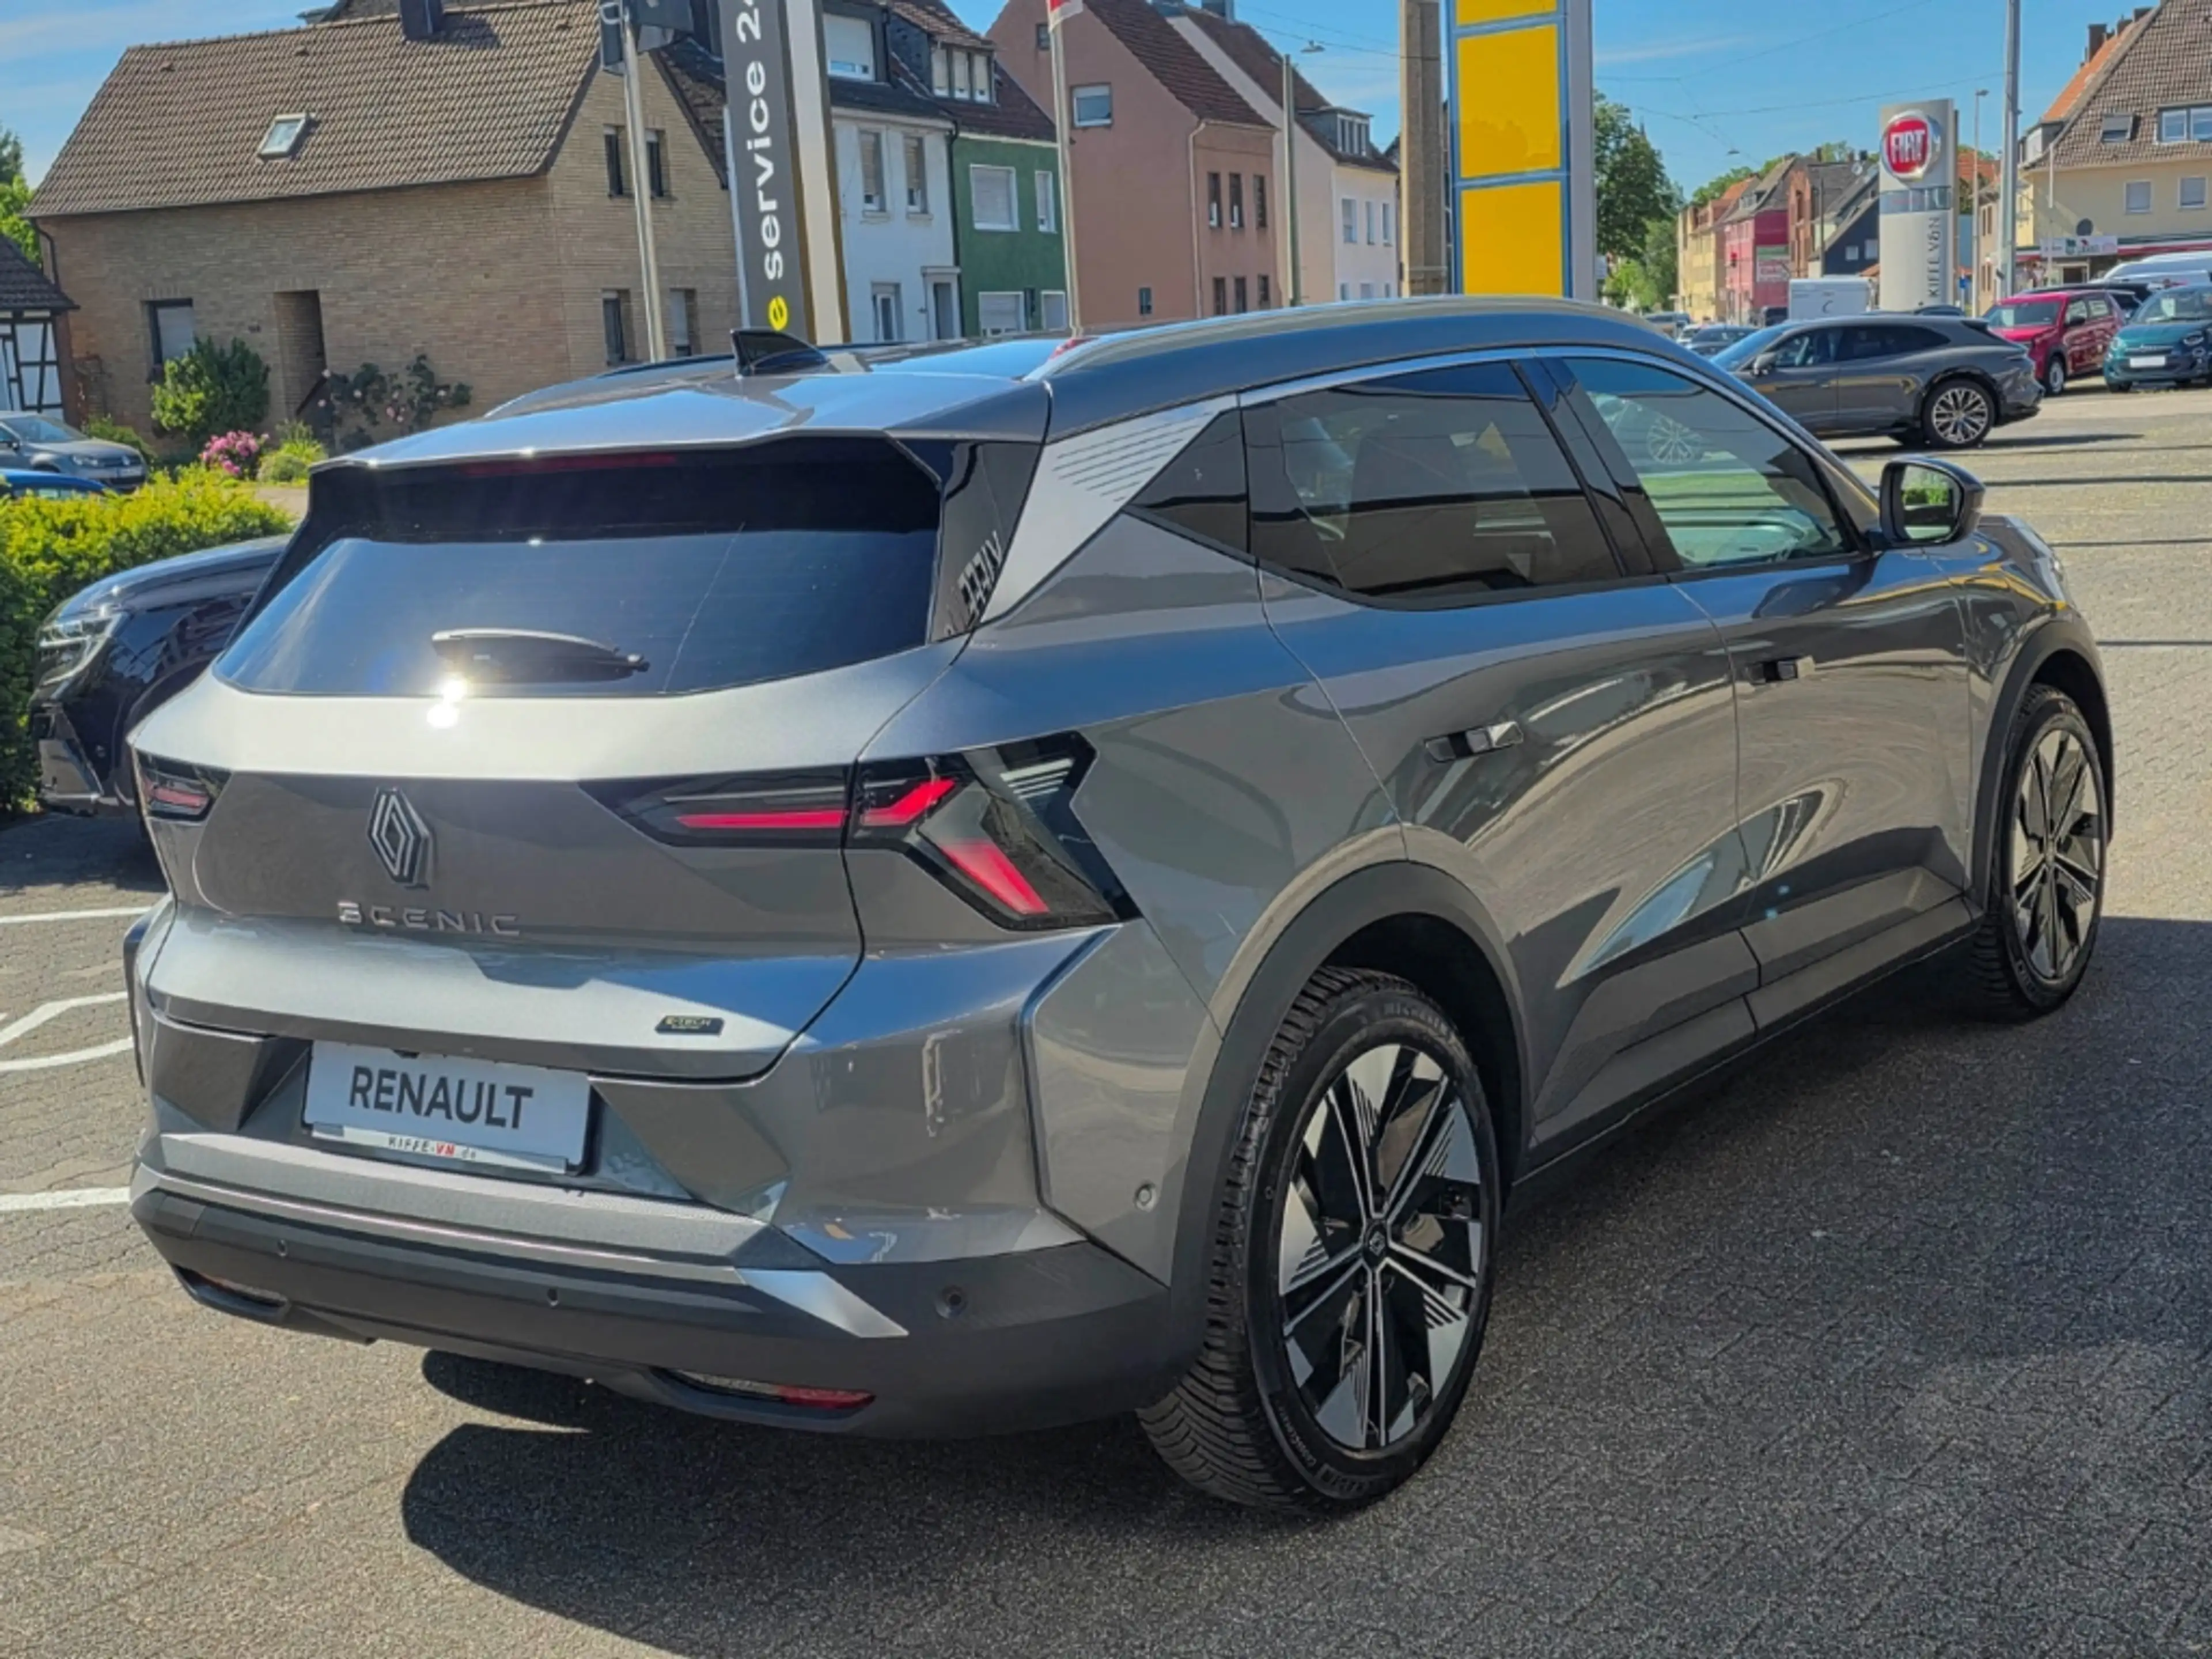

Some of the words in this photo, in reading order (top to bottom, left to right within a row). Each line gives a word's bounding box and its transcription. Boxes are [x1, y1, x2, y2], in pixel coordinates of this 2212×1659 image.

[736, 0, 762, 44] 2
[1890, 129, 1925, 163] FIAT
[746, 60, 784, 281] service
[337, 901, 520, 935] SCENIC
[349, 1066, 533, 1129] RENAULT
